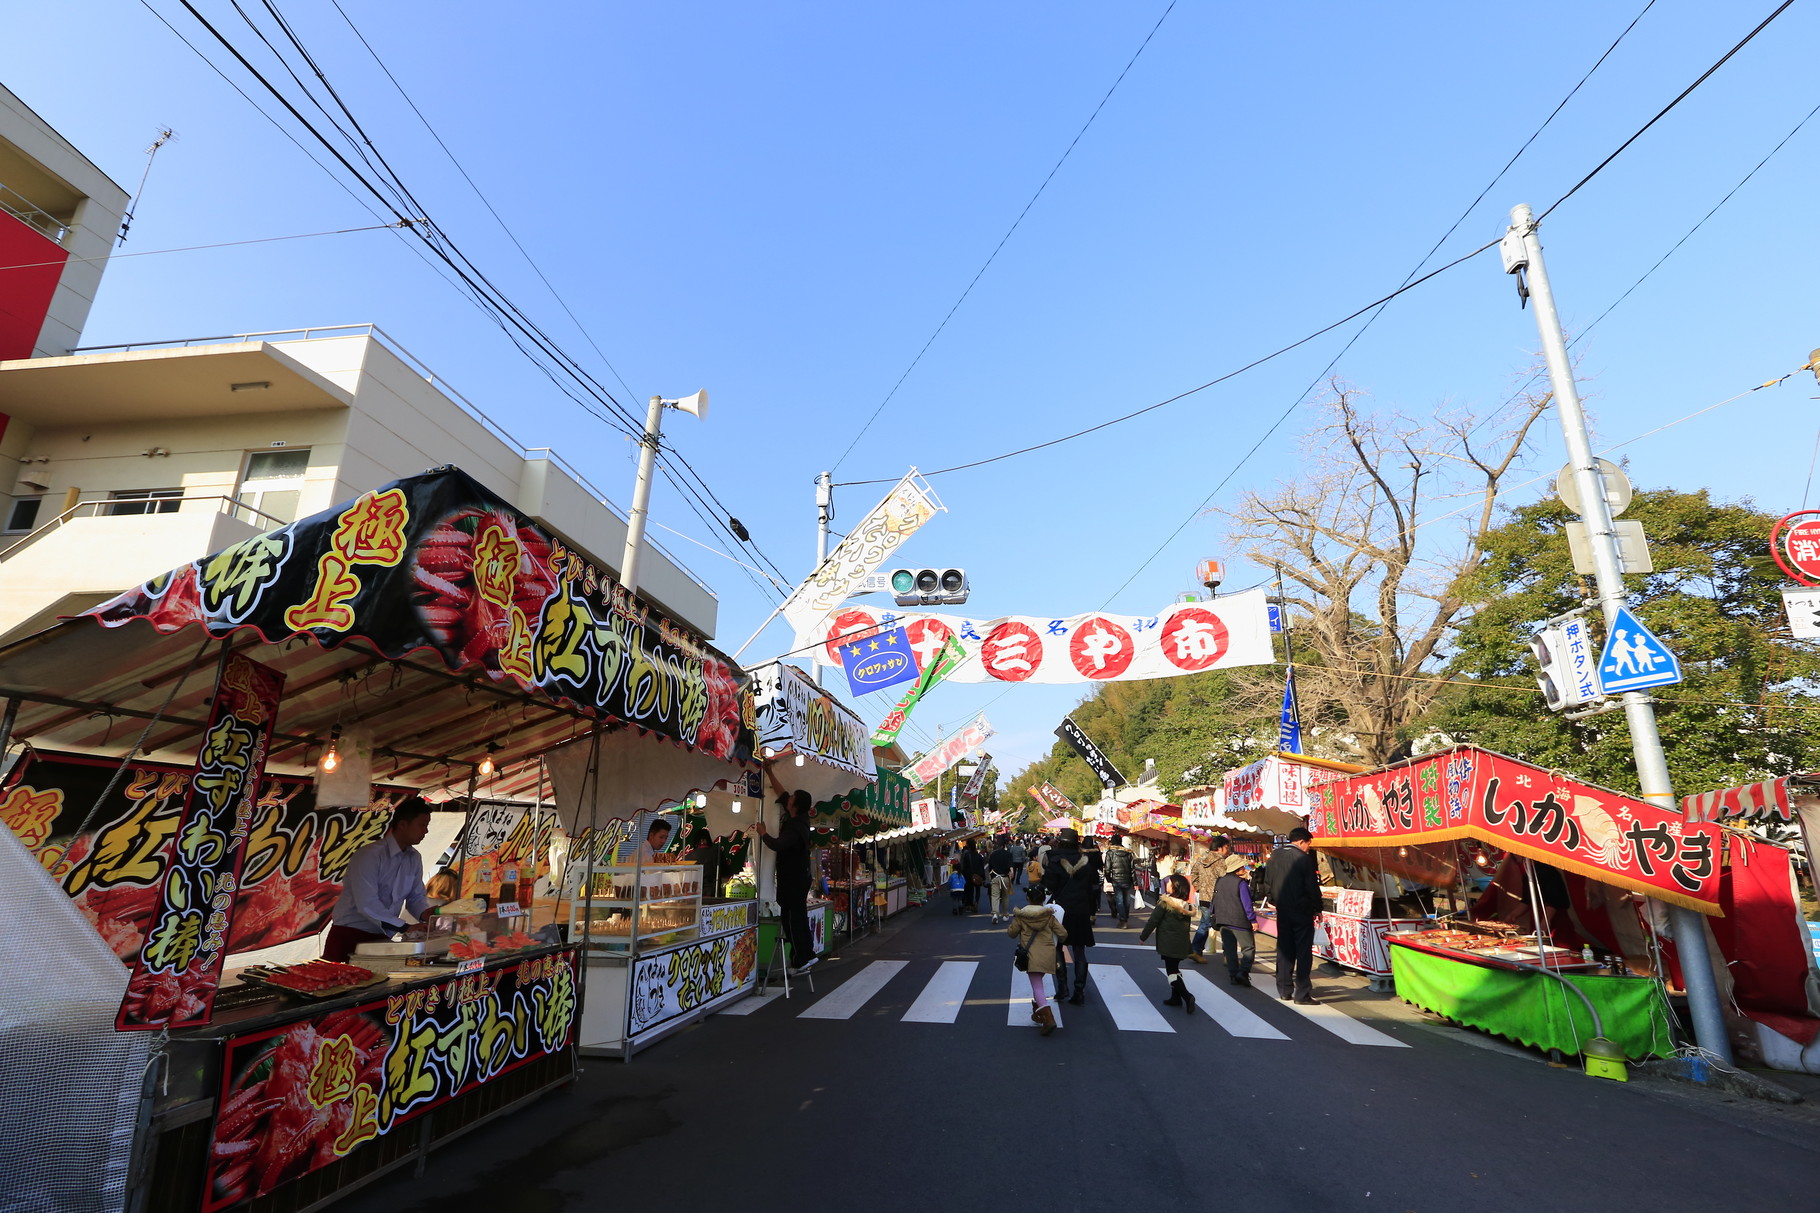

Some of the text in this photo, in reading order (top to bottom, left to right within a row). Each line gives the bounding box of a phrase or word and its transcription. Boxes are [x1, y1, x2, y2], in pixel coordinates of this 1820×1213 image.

[284, 488, 410, 633] 極上
[1793, 529, 1810, 537] FIRE
[472, 525, 535, 682] 極上
[858, 576, 886, 588] 信号
[224, 654, 264, 726] 極上
[531, 566, 709, 746] 紅ずわい棒
[857, 657, 904, 680] クロワッサン
[1566, 624, 1595, 698] 押ボタン式
[126, 768, 304, 807] とび上!
[1281, 764, 1299, 804] 味自慢
[1340, 778, 1414, 833] いかやき
[1421, 758, 1442, 827] 特製
[1515, 774, 1683, 838] 北海名産
[144, 715, 254, 977] 紅ずわい棒
[1484, 777, 1714, 892] いかやき
[201, 871, 238, 970] 北の恵み!
[386, 969, 504, 1026] とびきり極上!
[376, 962, 577, 1135] 紅ずわい棒
[307, 1033, 379, 1156] 極上
